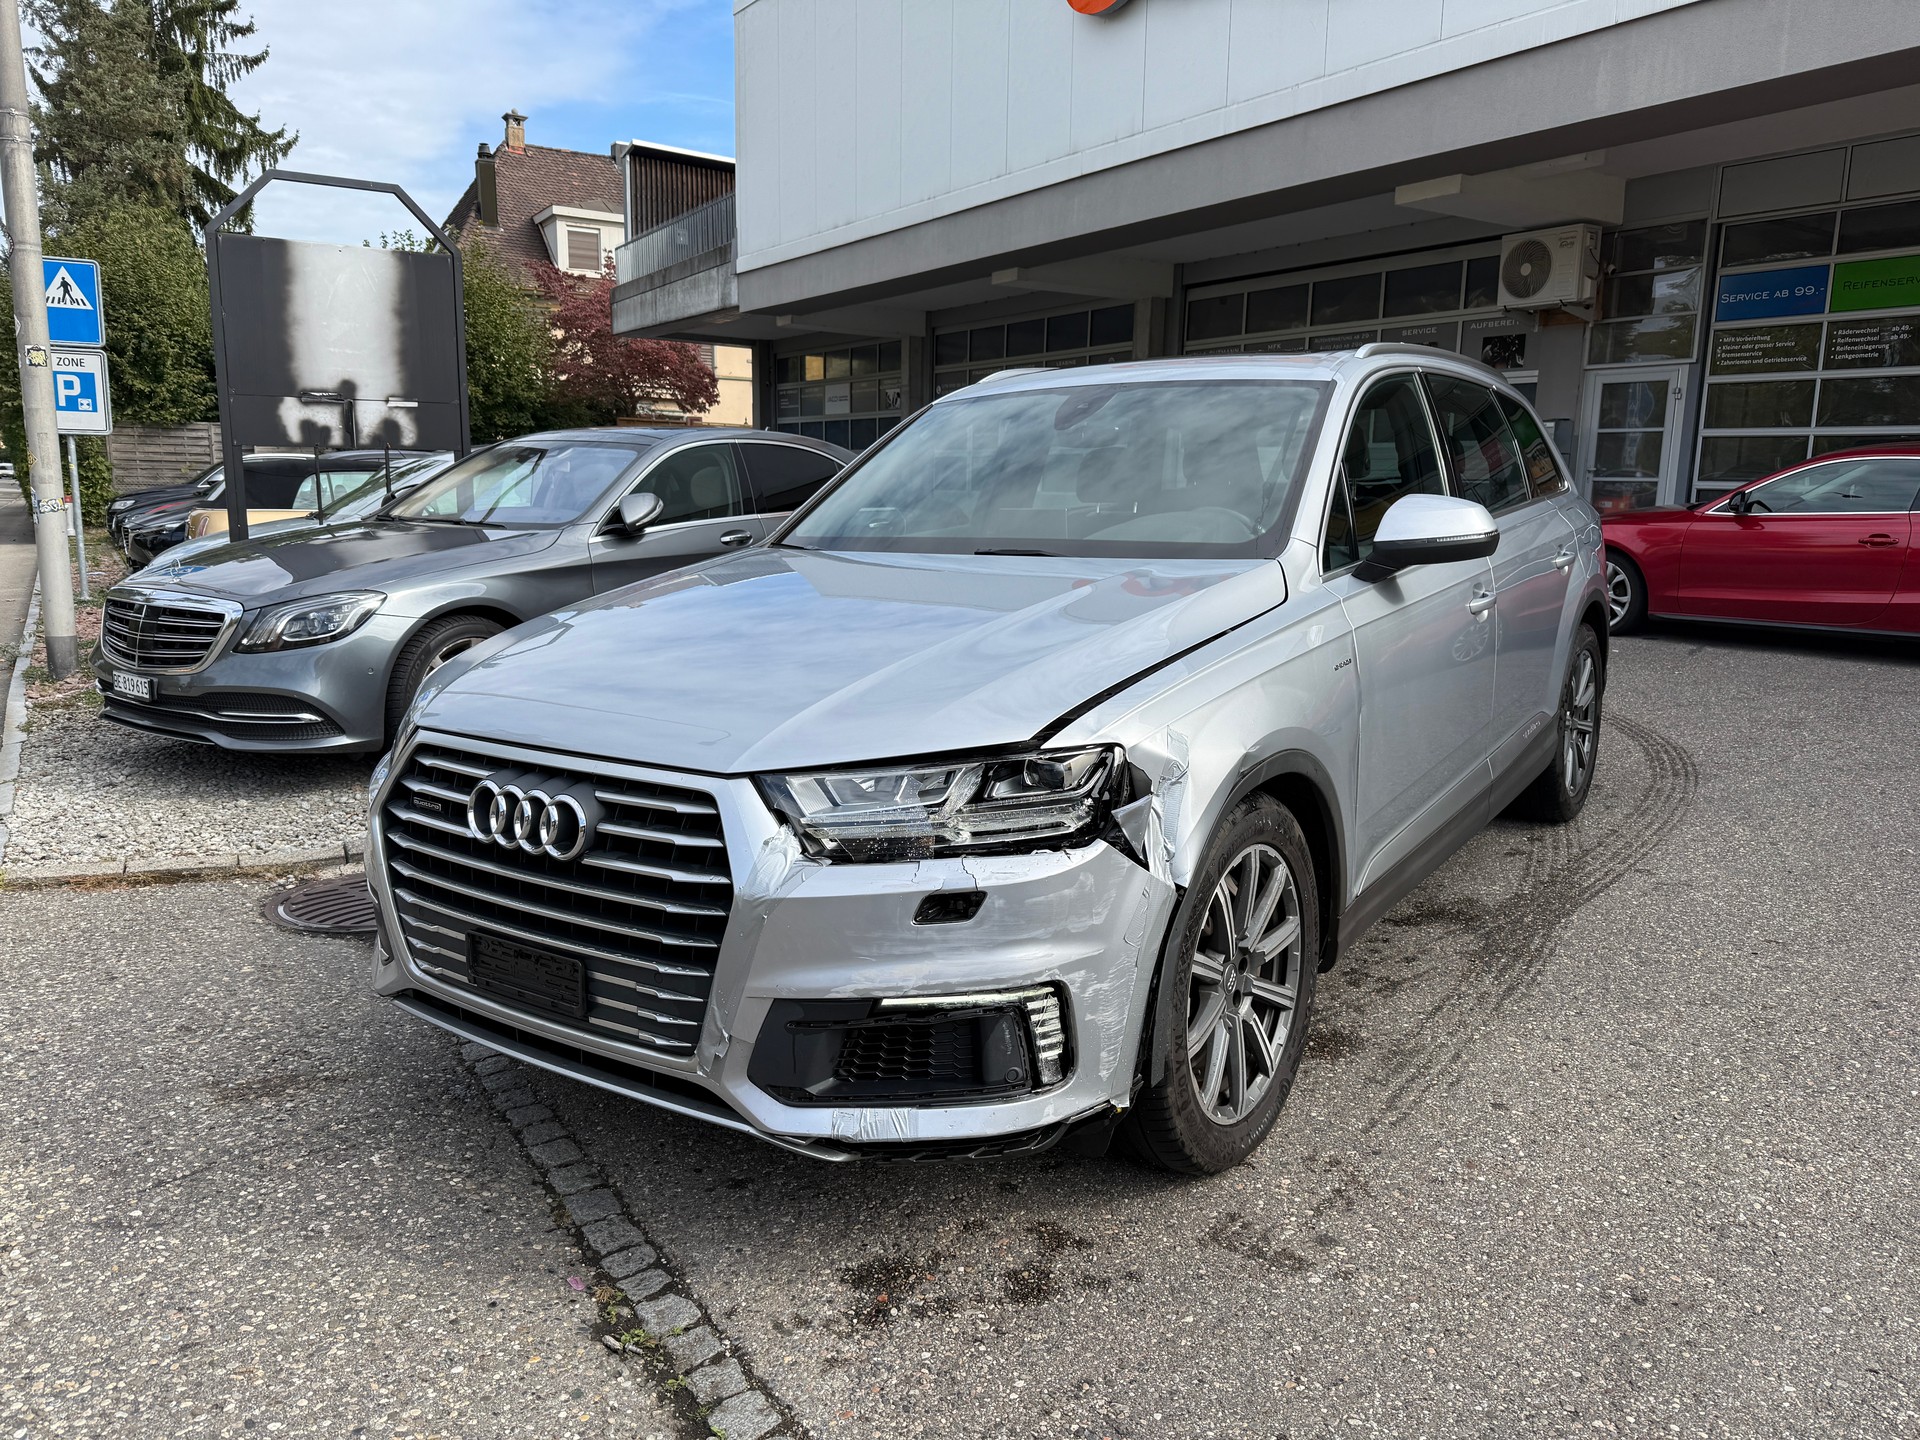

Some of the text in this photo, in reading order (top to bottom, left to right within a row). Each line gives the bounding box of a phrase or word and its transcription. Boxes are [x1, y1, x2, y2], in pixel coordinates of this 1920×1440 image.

[1401, 326, 1438, 337] SERVICE
[1837, 327, 1880, 335] Räderwechsel
[1736, 335, 1771, 343] Vorbereitung
[1837, 335, 1880, 343] Reifenwechsel
[1754, 342, 1774, 350] grosser
[1835, 344, 1890, 352] Reifeneinlagerung
[1763, 356, 1807, 364] Getriebeservice
[1834, 352, 1879, 360] Lenkgeometrie
[56, 356, 86, 368] ZONE
[56, 373, 82, 407] P
[413, 799, 440, 810] quattro
